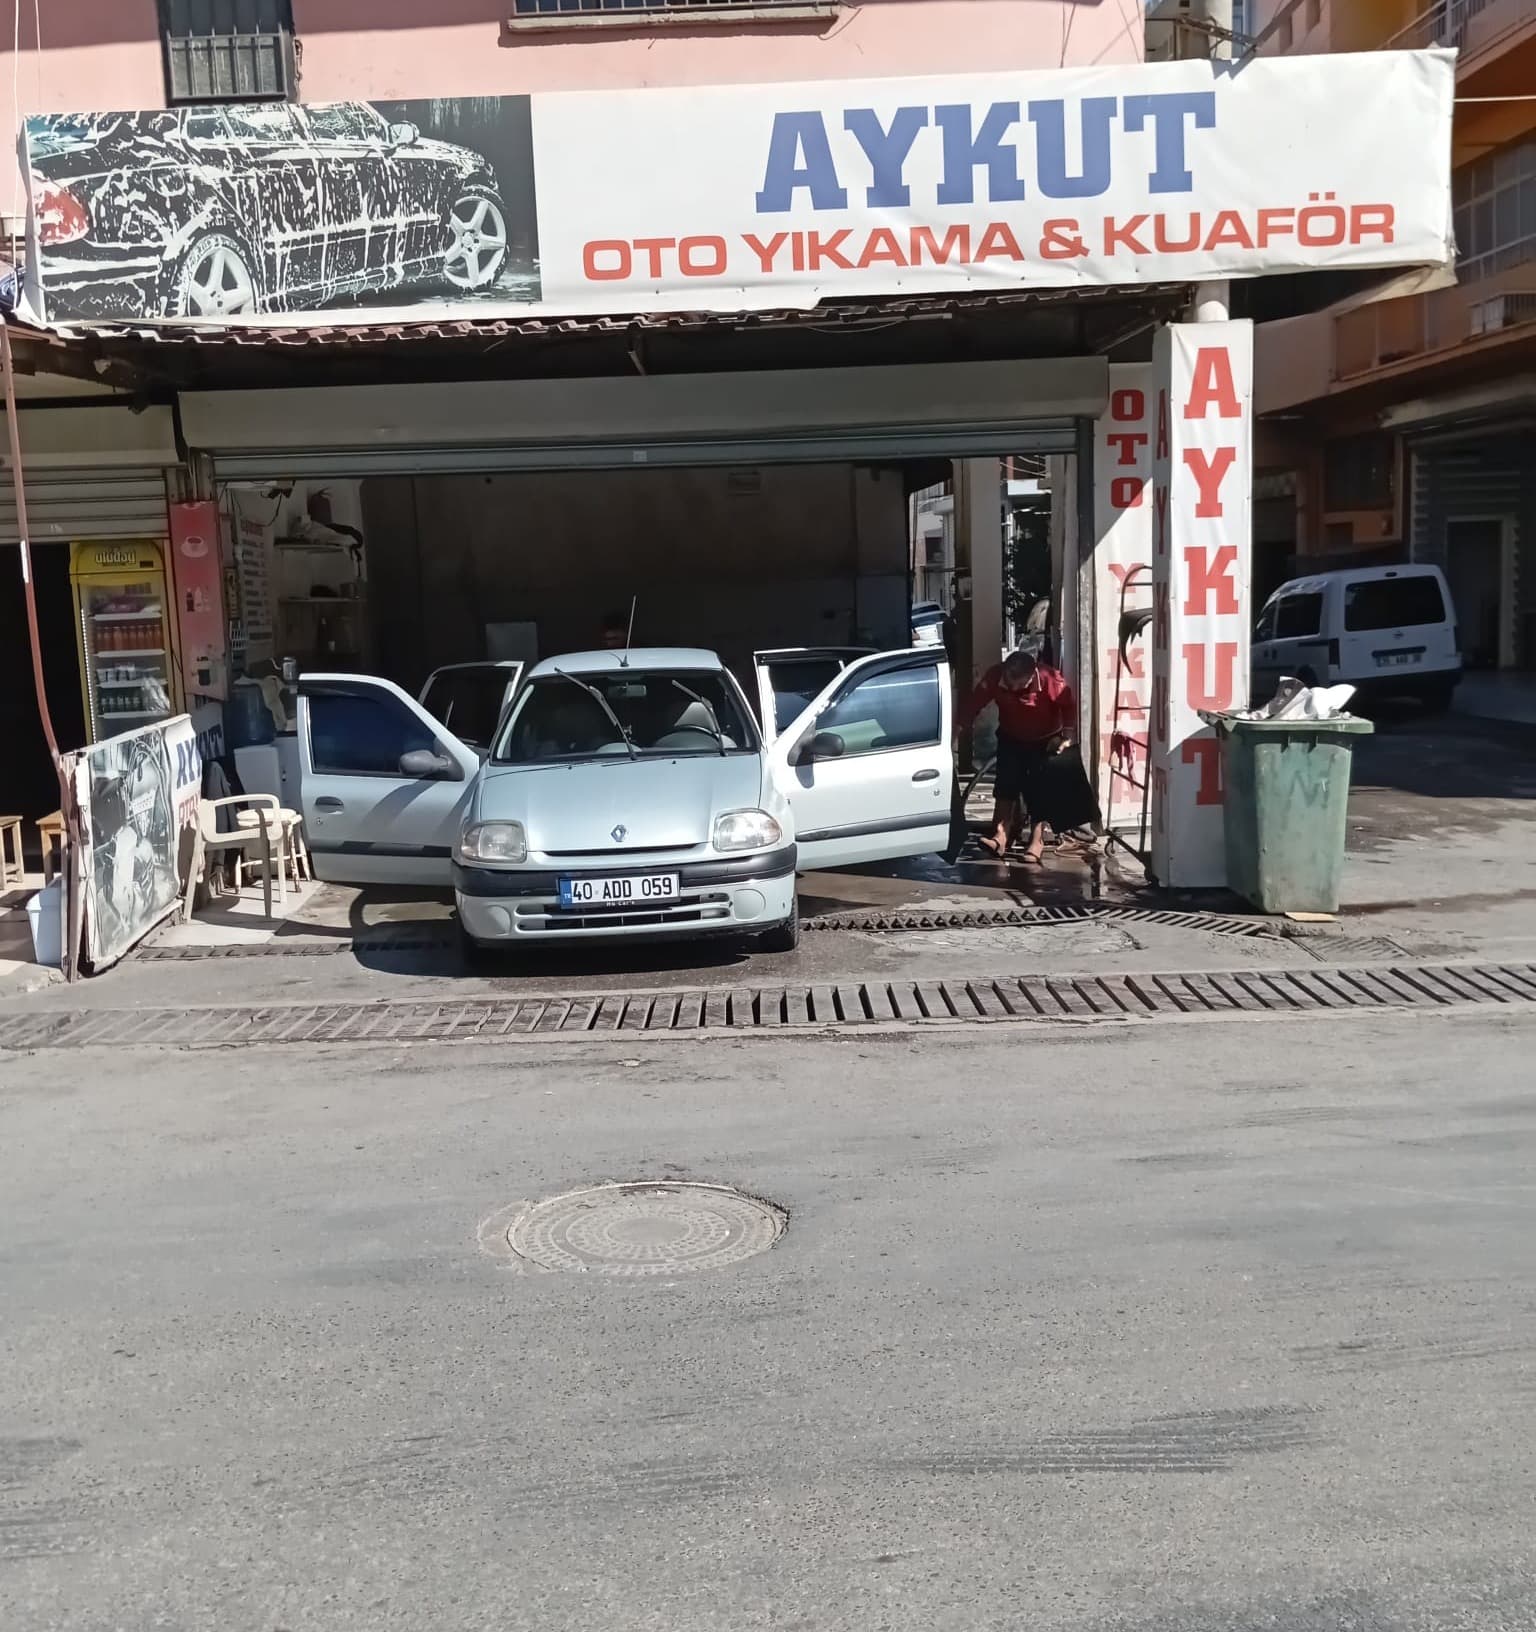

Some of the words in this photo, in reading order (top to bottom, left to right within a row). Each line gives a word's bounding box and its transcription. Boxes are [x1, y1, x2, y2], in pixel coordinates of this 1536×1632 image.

[757, 93, 1215, 212] AYKUT
[583, 235, 728, 281] OTO
[742, 222, 1025, 273] YIKAMA
[1039, 218, 1089, 260] &
[1103, 191, 1395, 257] KUAFÖR
[1105, 388, 1149, 509] OTO
[1183, 346, 1242, 806] AYKUT
[1101, 562, 1149, 805] YKAMA
[573, 882, 593, 900] 40
[602, 880, 632, 899] ADD
[641, 877, 672, 896] 059
